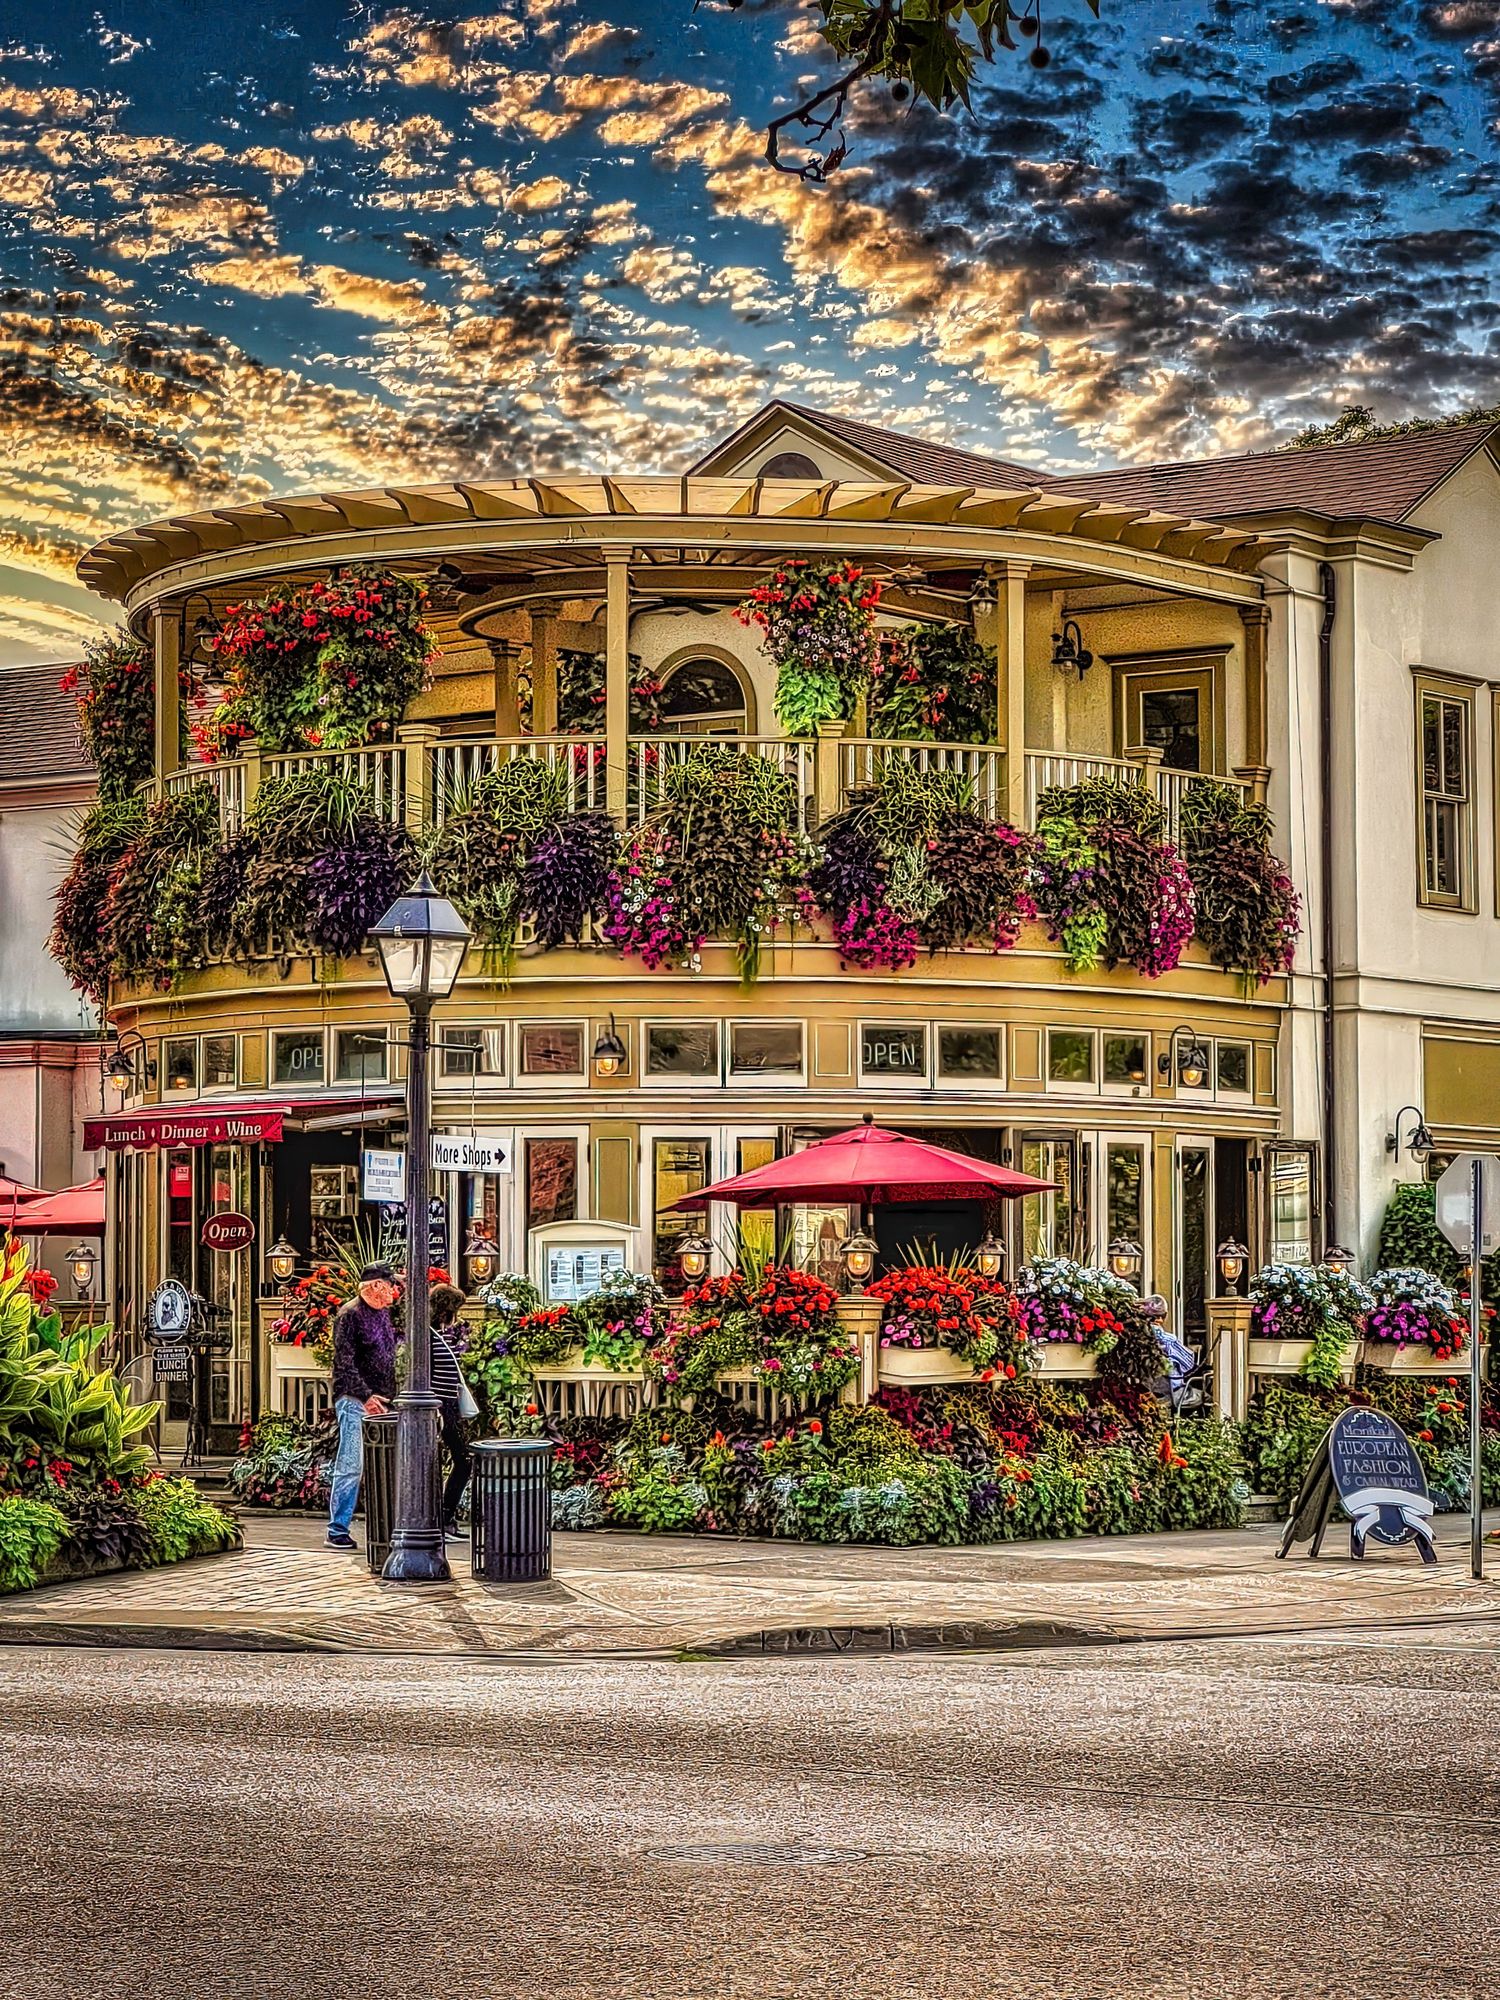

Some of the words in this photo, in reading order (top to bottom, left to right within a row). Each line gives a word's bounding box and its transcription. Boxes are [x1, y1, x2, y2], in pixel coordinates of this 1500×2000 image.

[515, 903, 614, 944] BR
[291, 1046, 323, 1070] OPE
[862, 1042, 915, 1066] OPEN
[104, 1126, 146, 1142] Lunch
[161, 1124, 208, 1140] Dinner
[226, 1121, 262, 1137] Wine
[435, 1143, 459, 1164] More
[462, 1144, 492, 1170] Shops
[208, 1223, 247, 1241] Open
[157, 1360, 187, 1370] LUNCH
[155, 1371, 188, 1382] DINNER
[1337, 1440, 1409, 1457] EUROPEAN
[1343, 1459, 1412, 1475] FASHION
